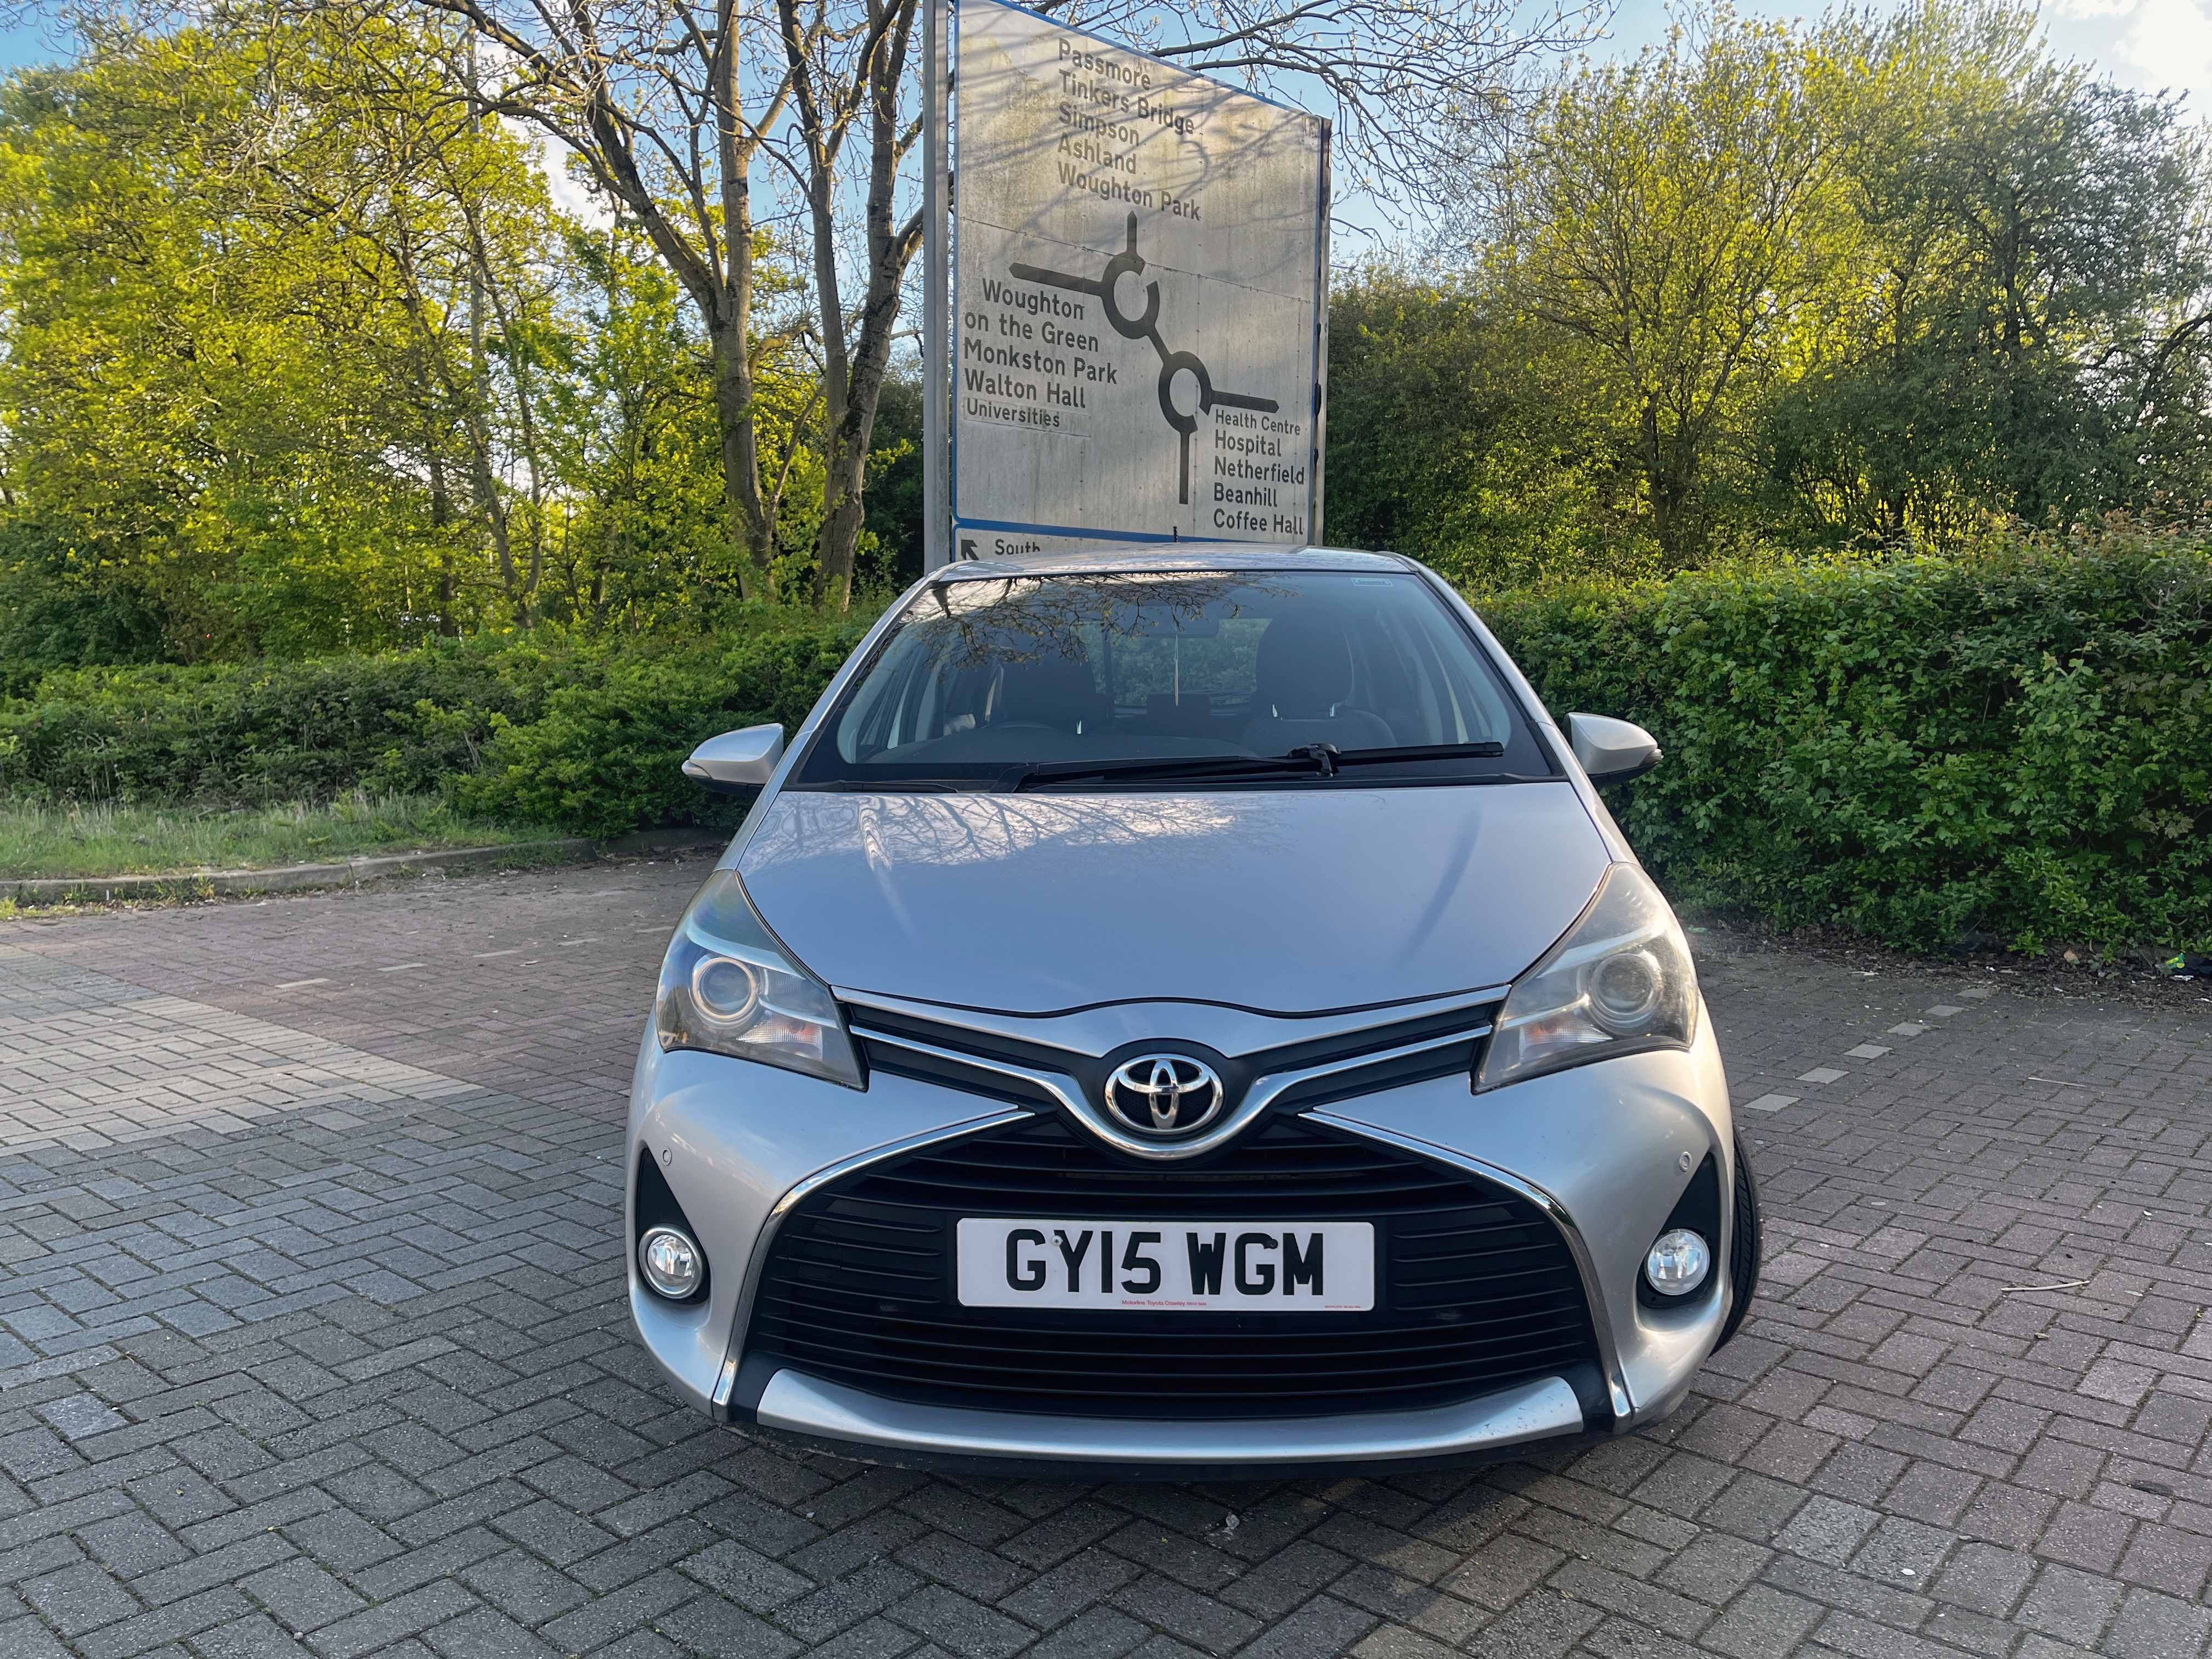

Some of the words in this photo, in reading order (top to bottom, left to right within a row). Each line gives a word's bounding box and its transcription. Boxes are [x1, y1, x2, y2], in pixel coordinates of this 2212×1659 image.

[1059, 37, 1150, 91] Passmore
[1059, 69, 1129, 114] Tinkers
[1138, 95, 1194, 134] Bridge
[1058, 101, 1139, 147] Simpson
[1058, 132, 1136, 175] Ashland
[1058, 161, 1153, 208] Woughton
[1161, 190, 1201, 221] Park
[983, 278, 1084, 320] Woughton
[964, 312, 989, 331] on
[999, 313, 1032, 339] the
[1042, 321, 1098, 352] Green
[964, 337, 1065, 376] Monkston
[1074, 357, 1118, 384] Park
[964, 368, 1037, 400] Walton
[1047, 381, 1086, 408] Hall
[967, 398, 1060, 427] Universities
[1215, 409, 1257, 431] Health
[1261, 416, 1301, 436] Centre
[1215, 430, 1282, 458] Hospital
[1214, 456, 1304, 485] Netherfield
[1214, 483, 1277, 507] Beanhill
[1214, 509, 1267, 532] Coffee
[1273, 515, 1304, 535] Hall
[1006, 1228, 1161, 1294] GY15
[1186, 1232, 1323, 1296] WGM
